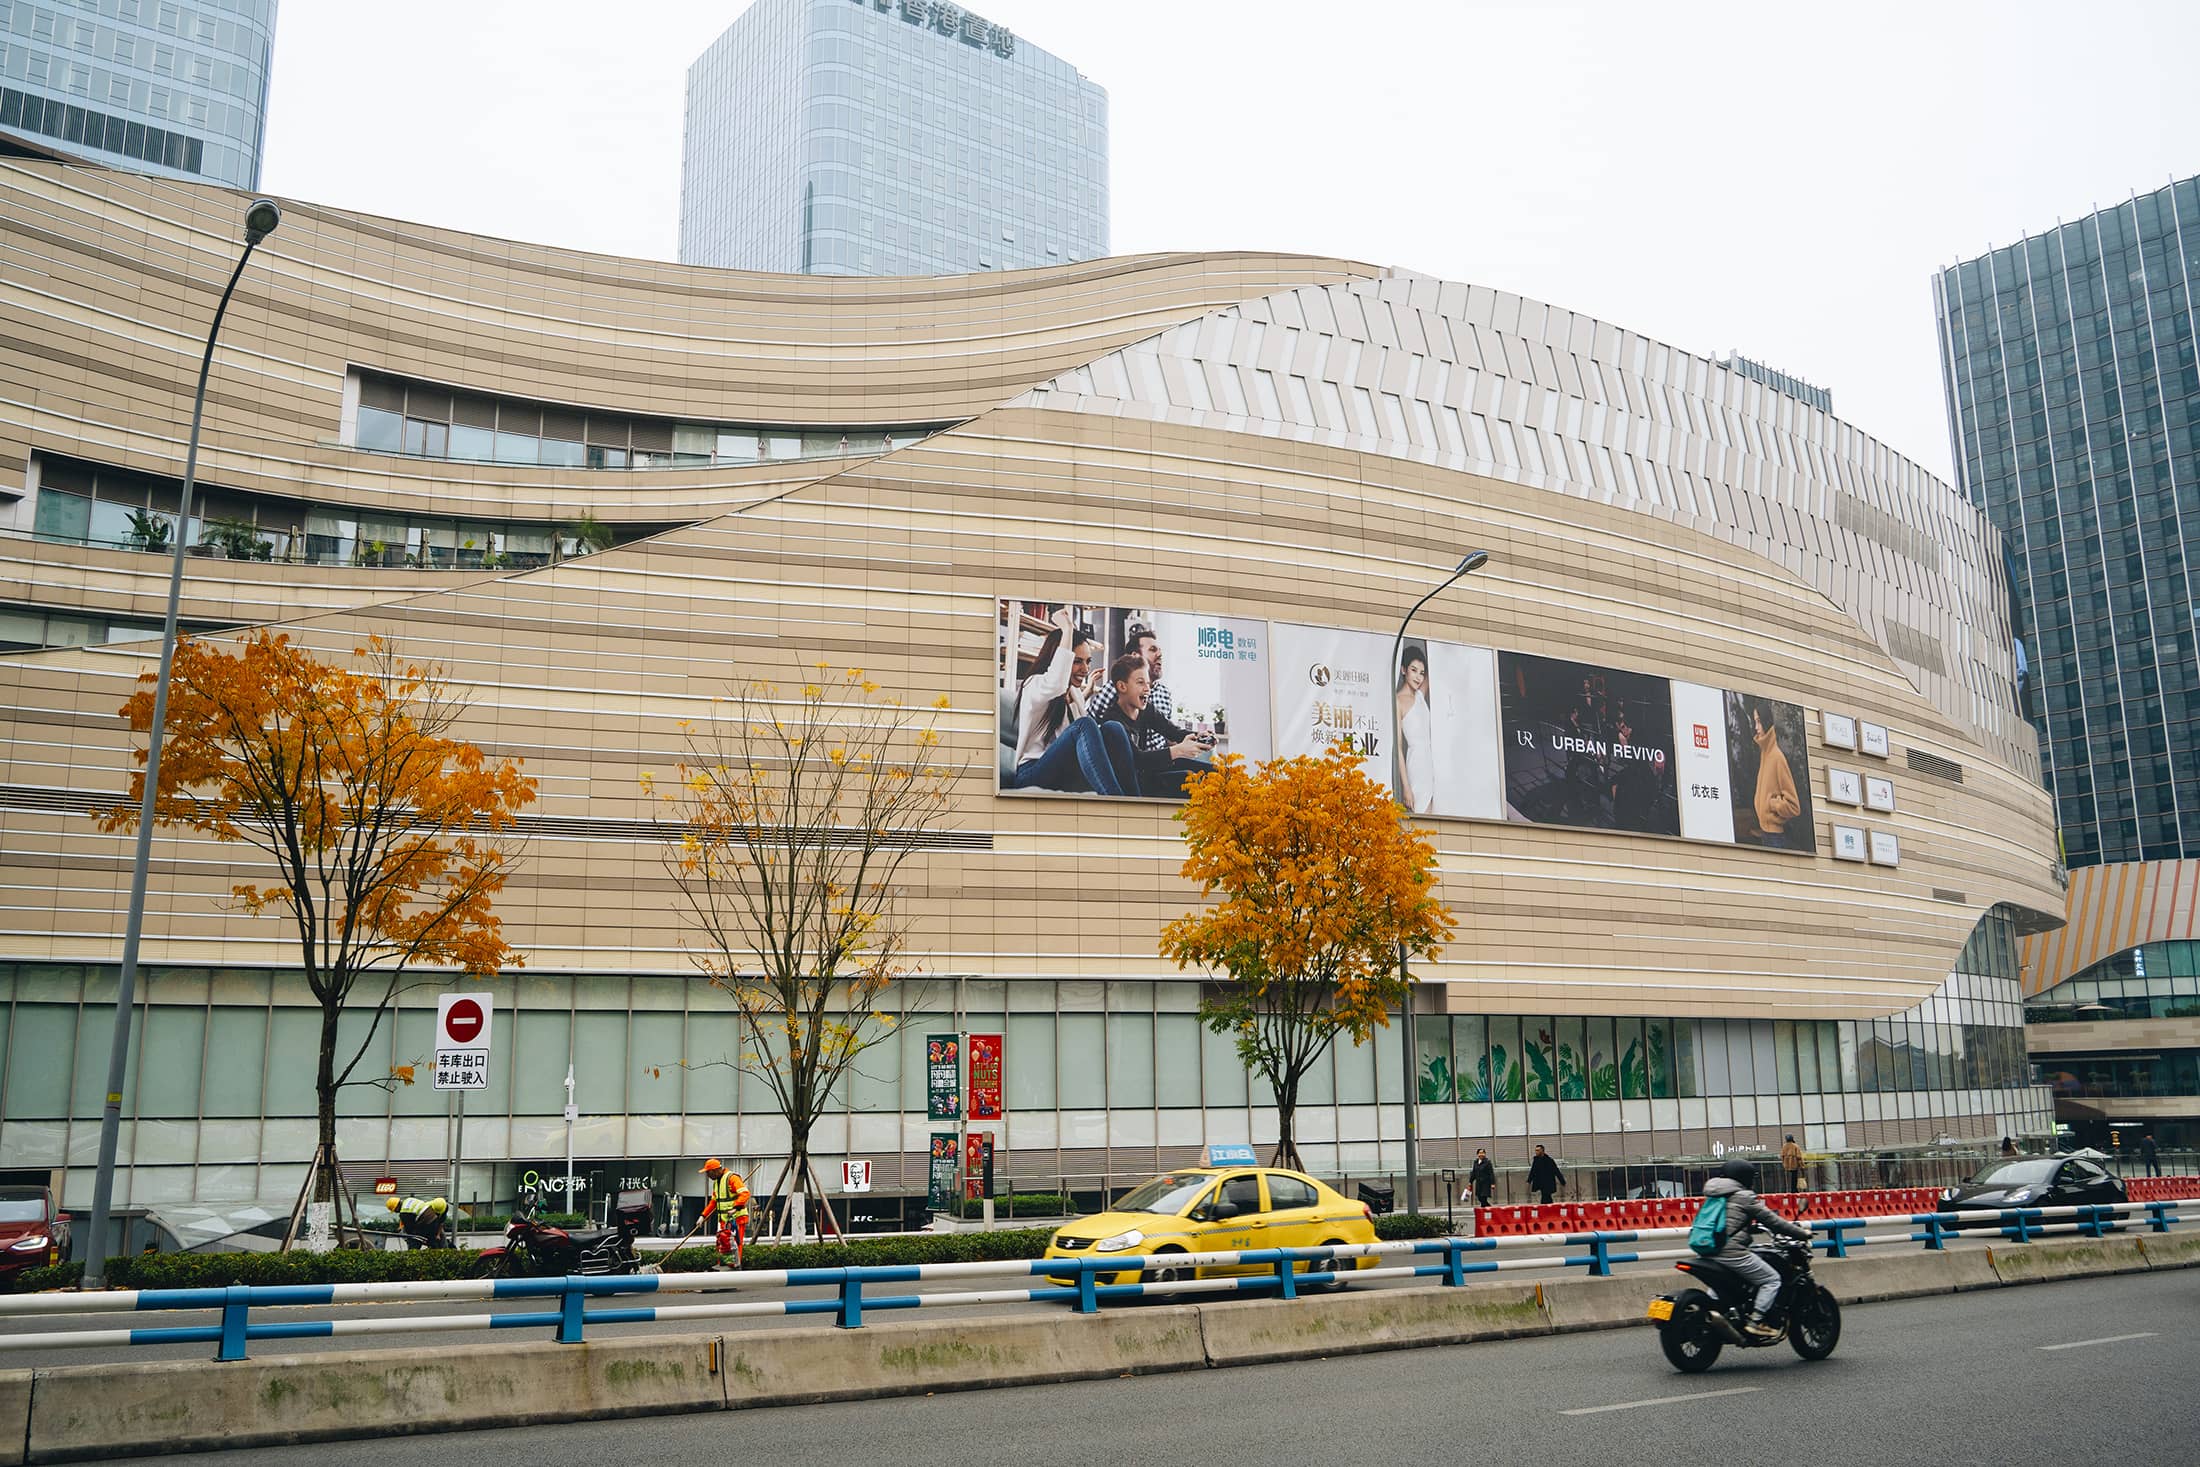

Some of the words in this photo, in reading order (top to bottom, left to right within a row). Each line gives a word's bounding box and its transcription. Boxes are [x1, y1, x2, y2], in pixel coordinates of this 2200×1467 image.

[1198, 627, 1234, 649] 顺电
[1198, 649, 1234, 660] sundan
[1238, 651, 1256, 661] 家电
[1552, 735, 1607, 755] URBAN
[1613, 743, 1665, 763] REVIVO
[1691, 783, 1719, 800] 优衣库
[439, 1054, 485, 1067] 车库出口
[437, 1071, 484, 1085] 禁止驶入
[973, 1069, 998, 1080] NUTS
[376, 1183, 396, 1192] LEGO
